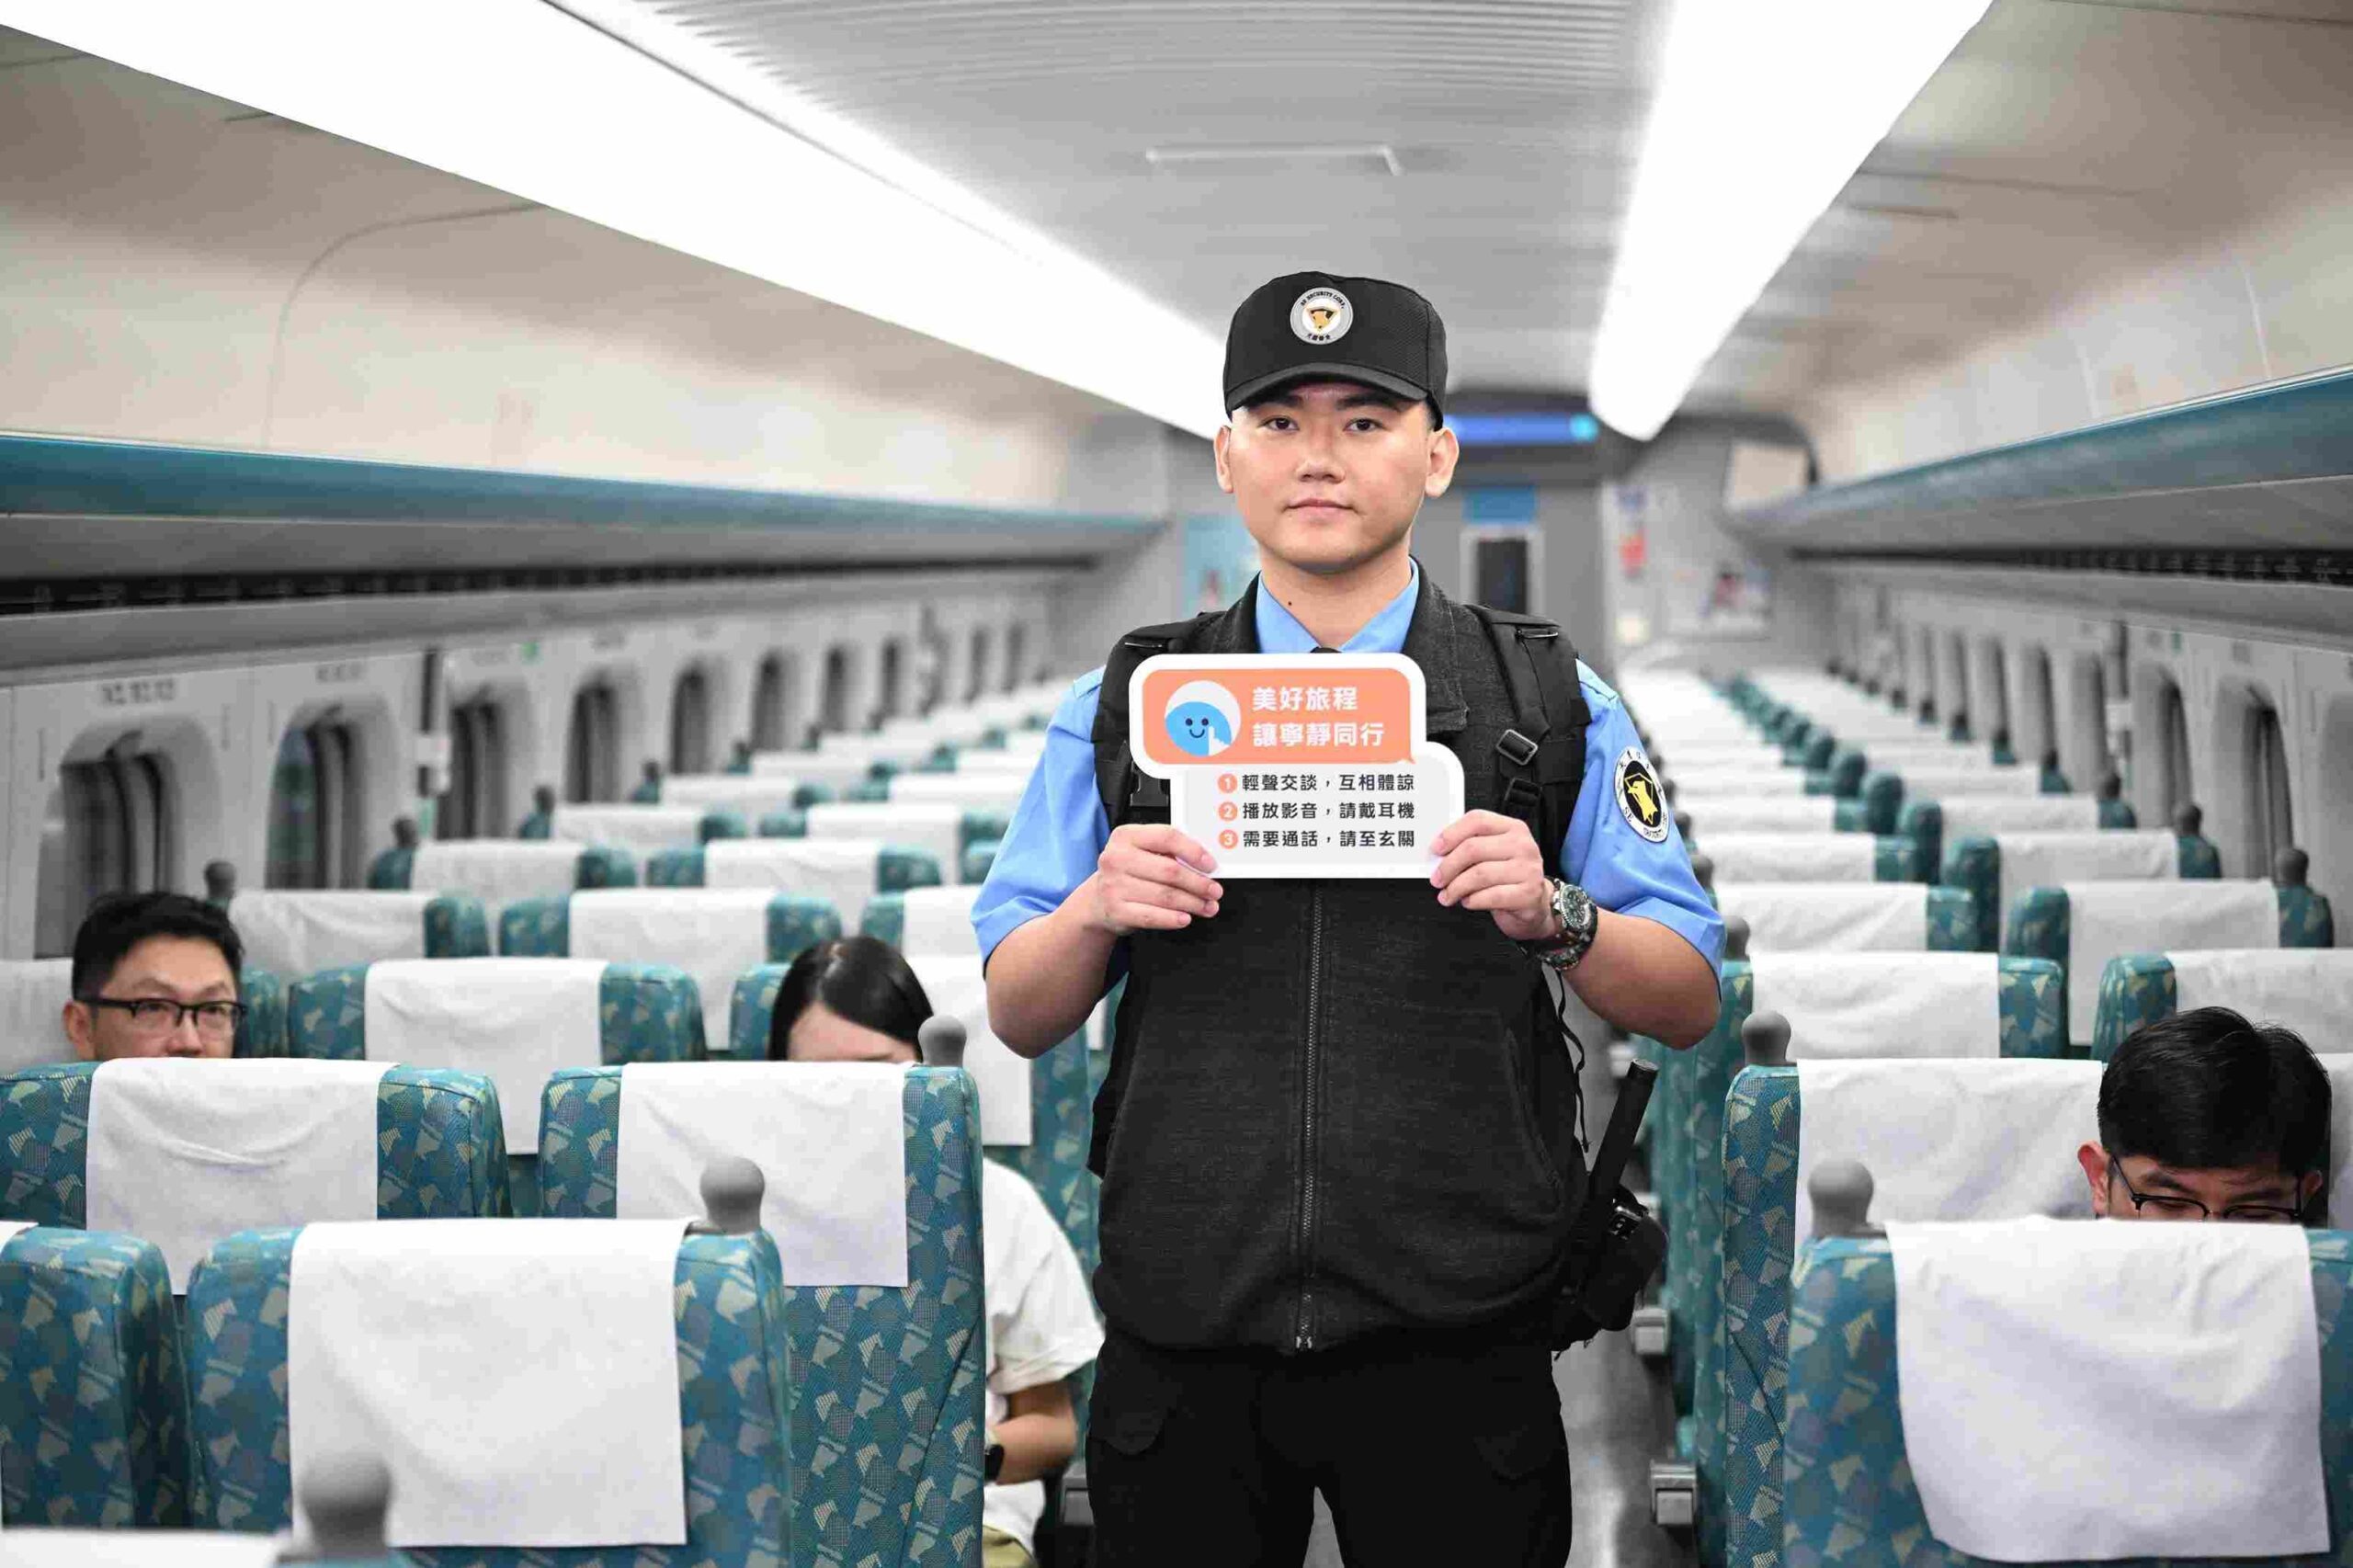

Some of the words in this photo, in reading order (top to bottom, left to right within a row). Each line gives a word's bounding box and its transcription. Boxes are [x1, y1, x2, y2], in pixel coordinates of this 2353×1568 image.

[1252, 687, 1358, 711] 美好旅程
[1252, 722, 1385, 747] 讓寧靜同行
